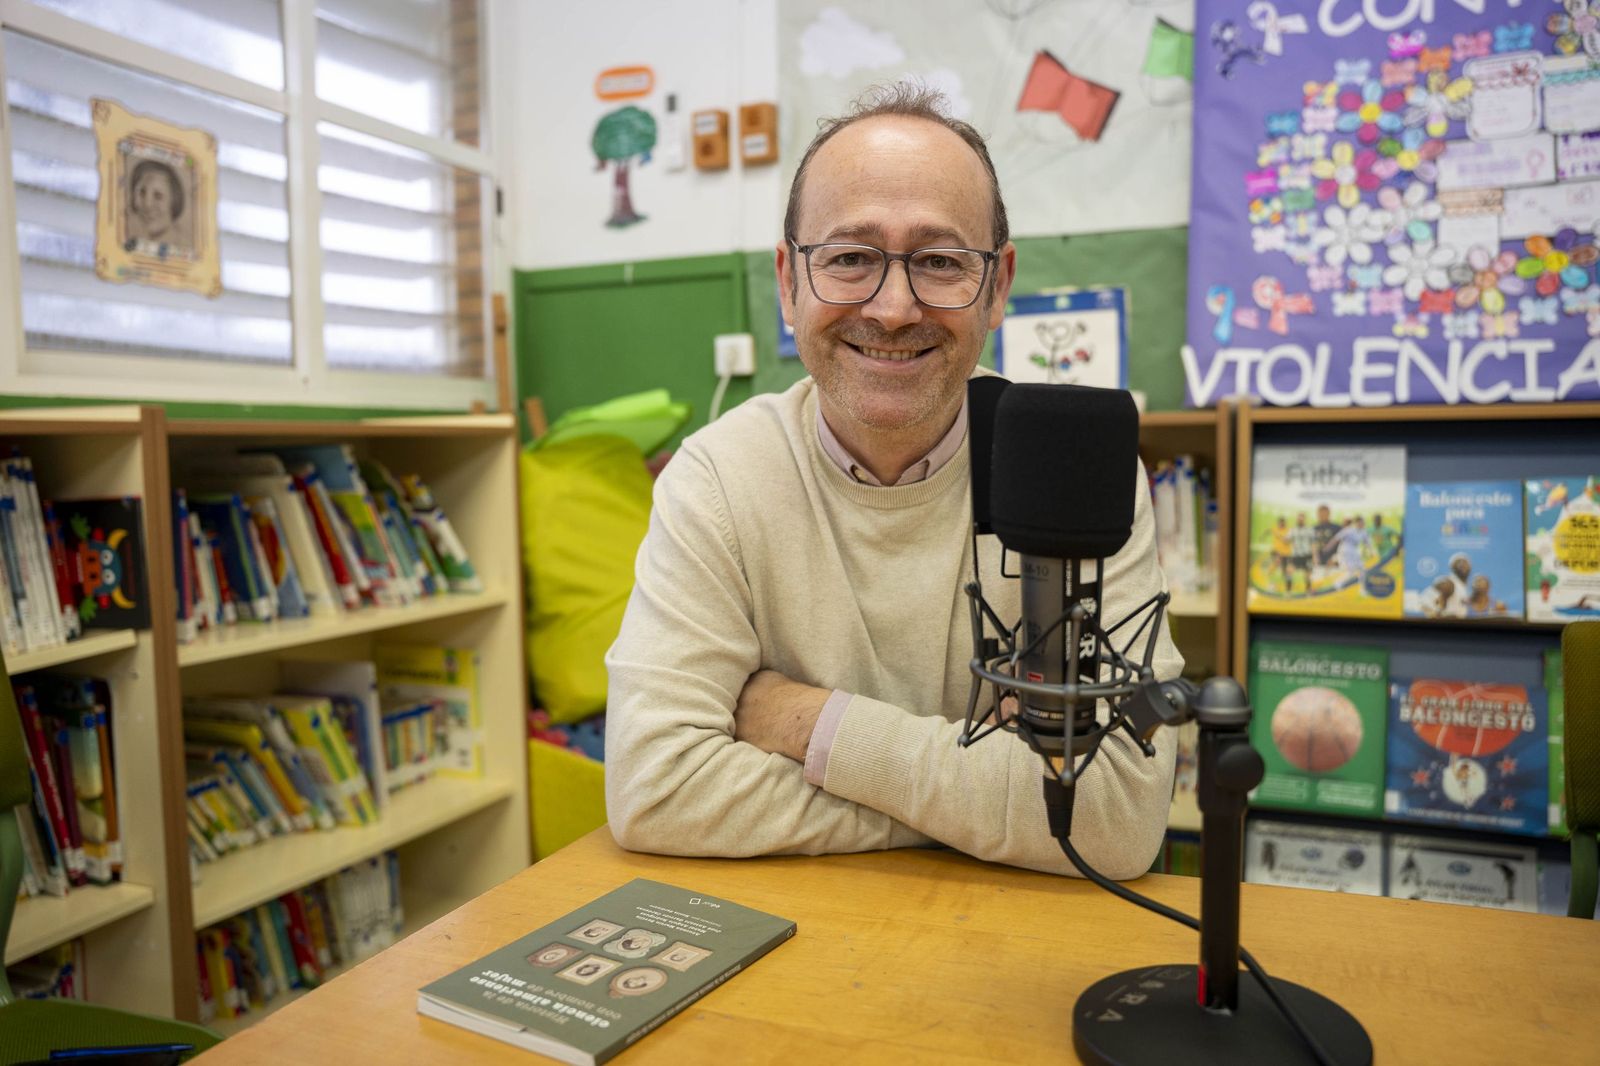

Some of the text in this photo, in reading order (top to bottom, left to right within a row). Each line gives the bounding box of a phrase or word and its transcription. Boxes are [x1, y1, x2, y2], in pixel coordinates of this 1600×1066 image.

[1180, 336, 1600, 408] VIOLENCIA
[1285, 461, 1369, 487] Fútbol
[1258, 656, 1382, 680] BALONCESTO
[1399, 703, 1536, 732] BALONCESTO
[482, 970, 527, 988] mujer
[469, 976, 611, 1028] ciencia almeriense
[544, 989, 596, 1010] nombre
